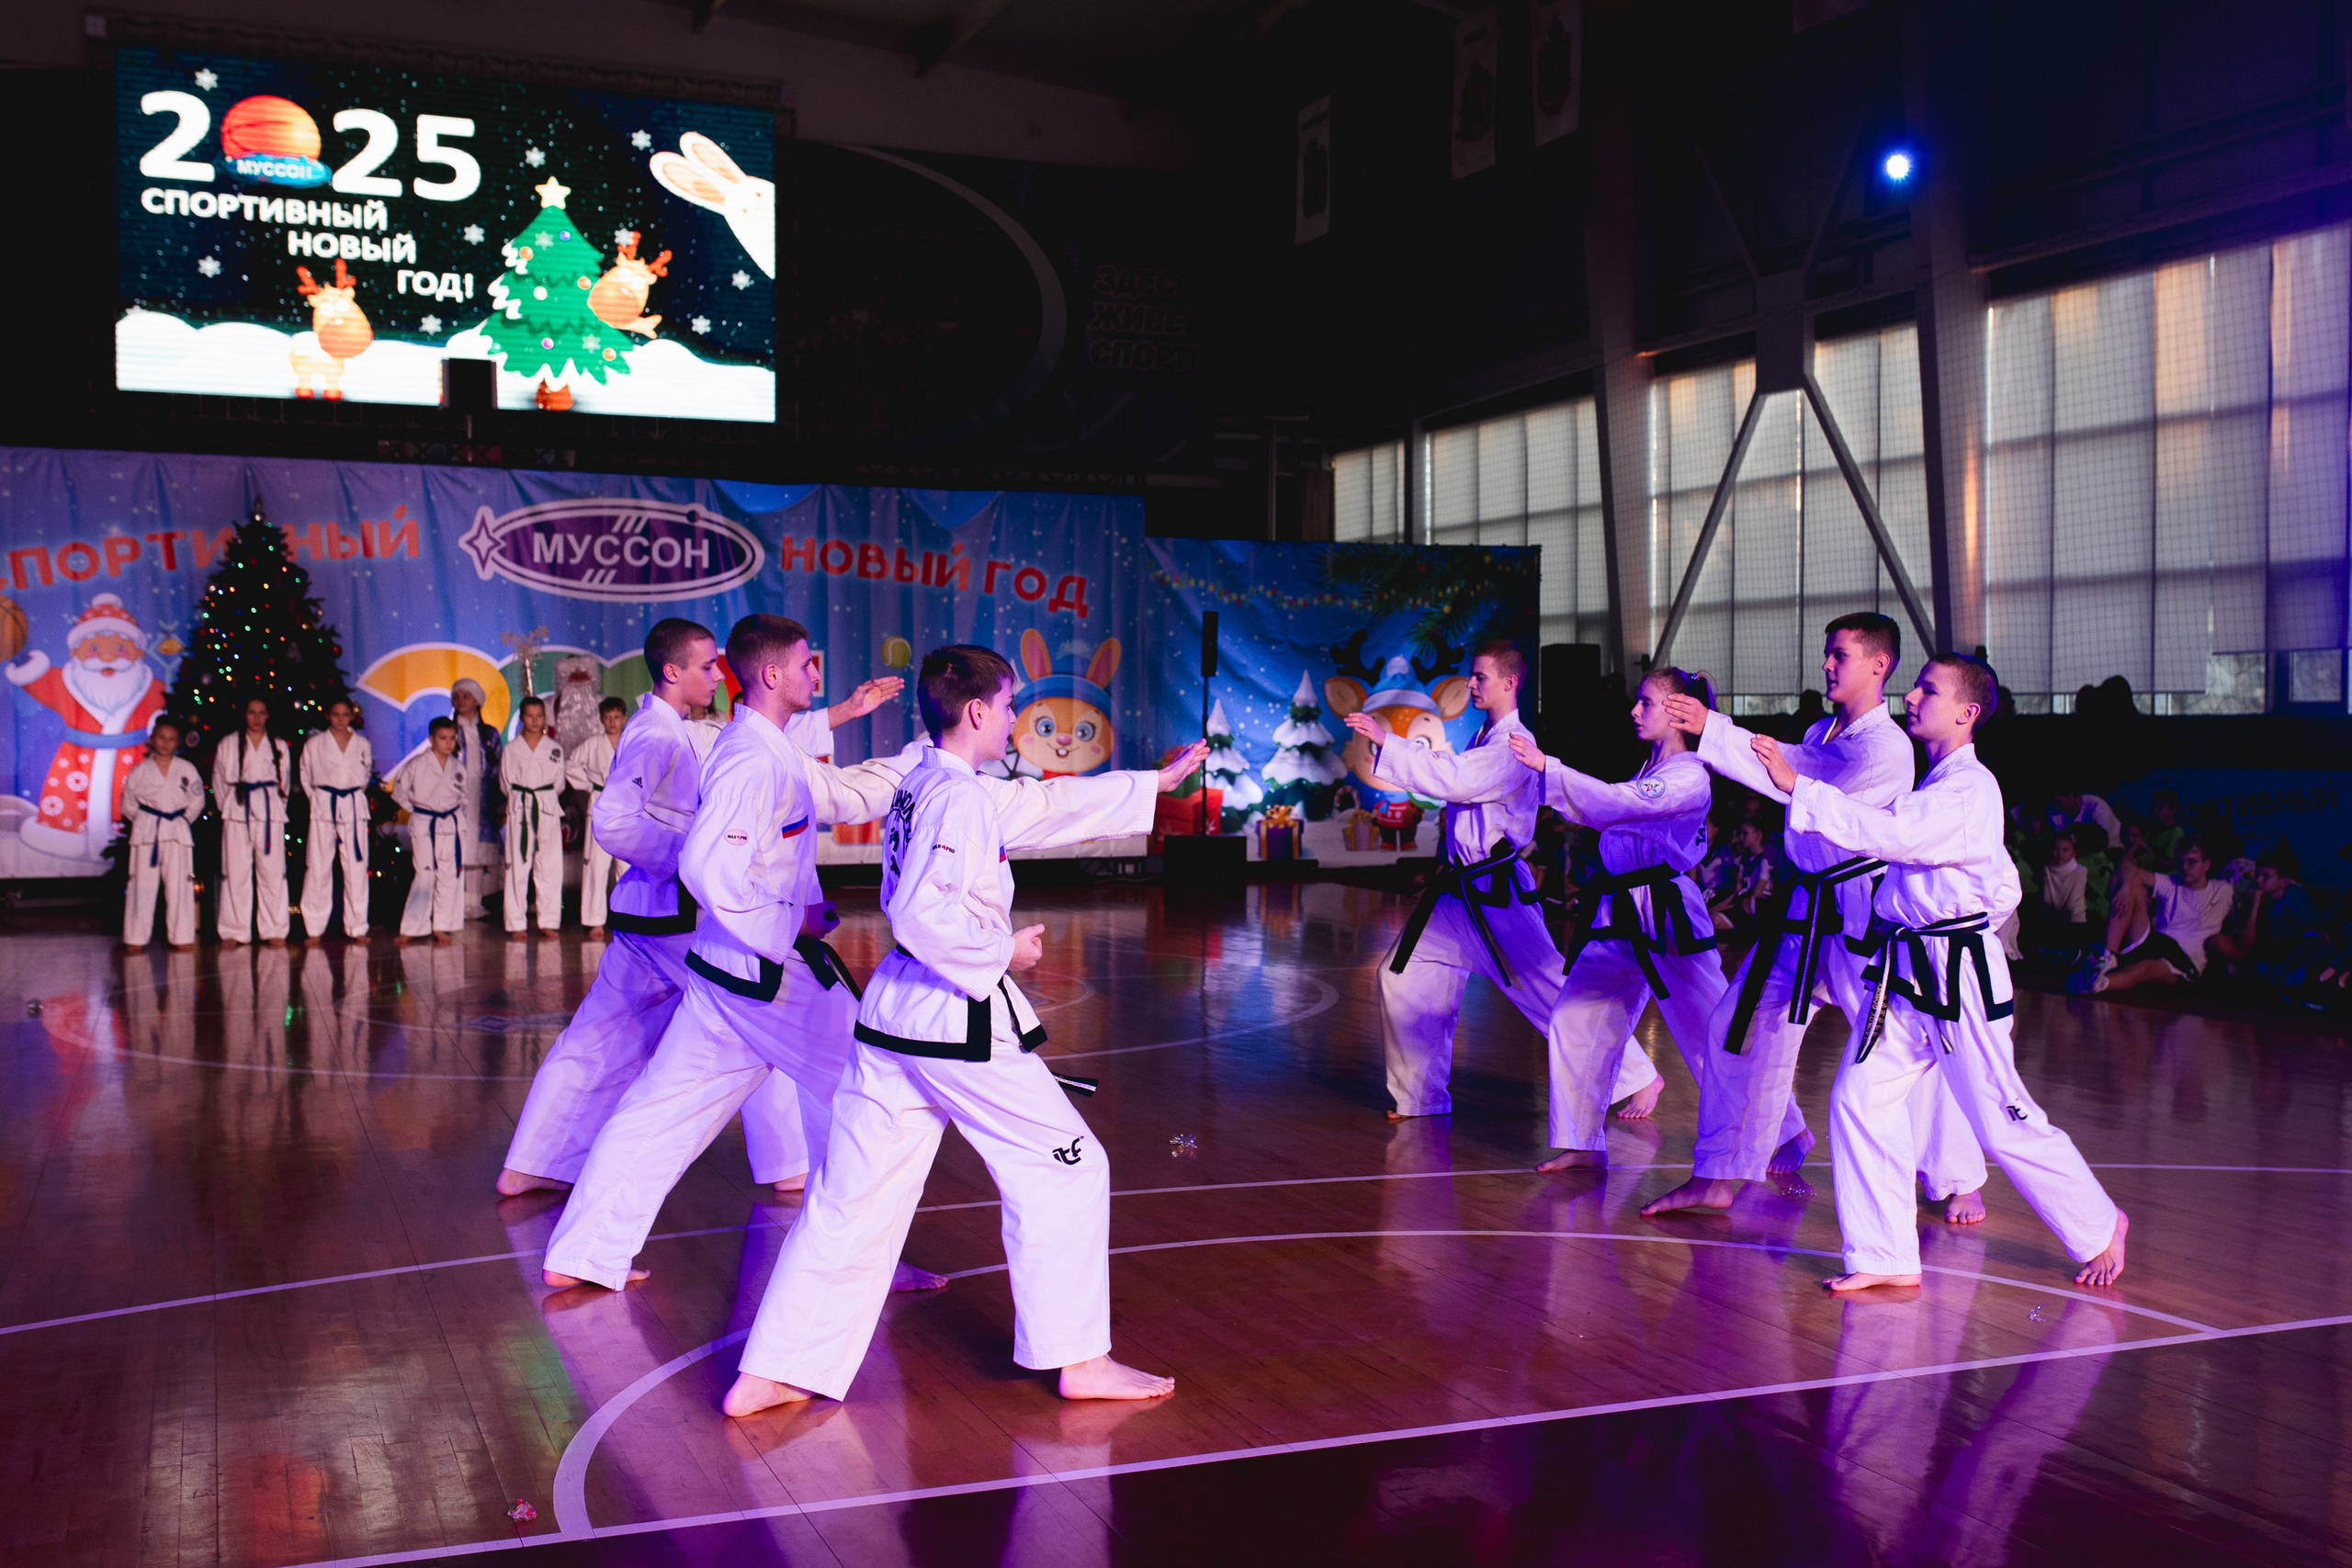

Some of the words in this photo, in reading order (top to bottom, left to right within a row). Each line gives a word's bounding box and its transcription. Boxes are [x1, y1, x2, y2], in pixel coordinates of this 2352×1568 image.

[140, 187, 389, 231] СПОРТИВНЫЙ
[287, 230, 418, 265] НОВЫЙ
[397, 270, 475, 301] ГОД!
[0, 503, 420, 591] ПОРТИНЫЙ
[532, 532, 711, 570] МУССОН
[780, 535, 971, 592] НОВЫЙ
[982, 560, 1089, 618] ГОД
